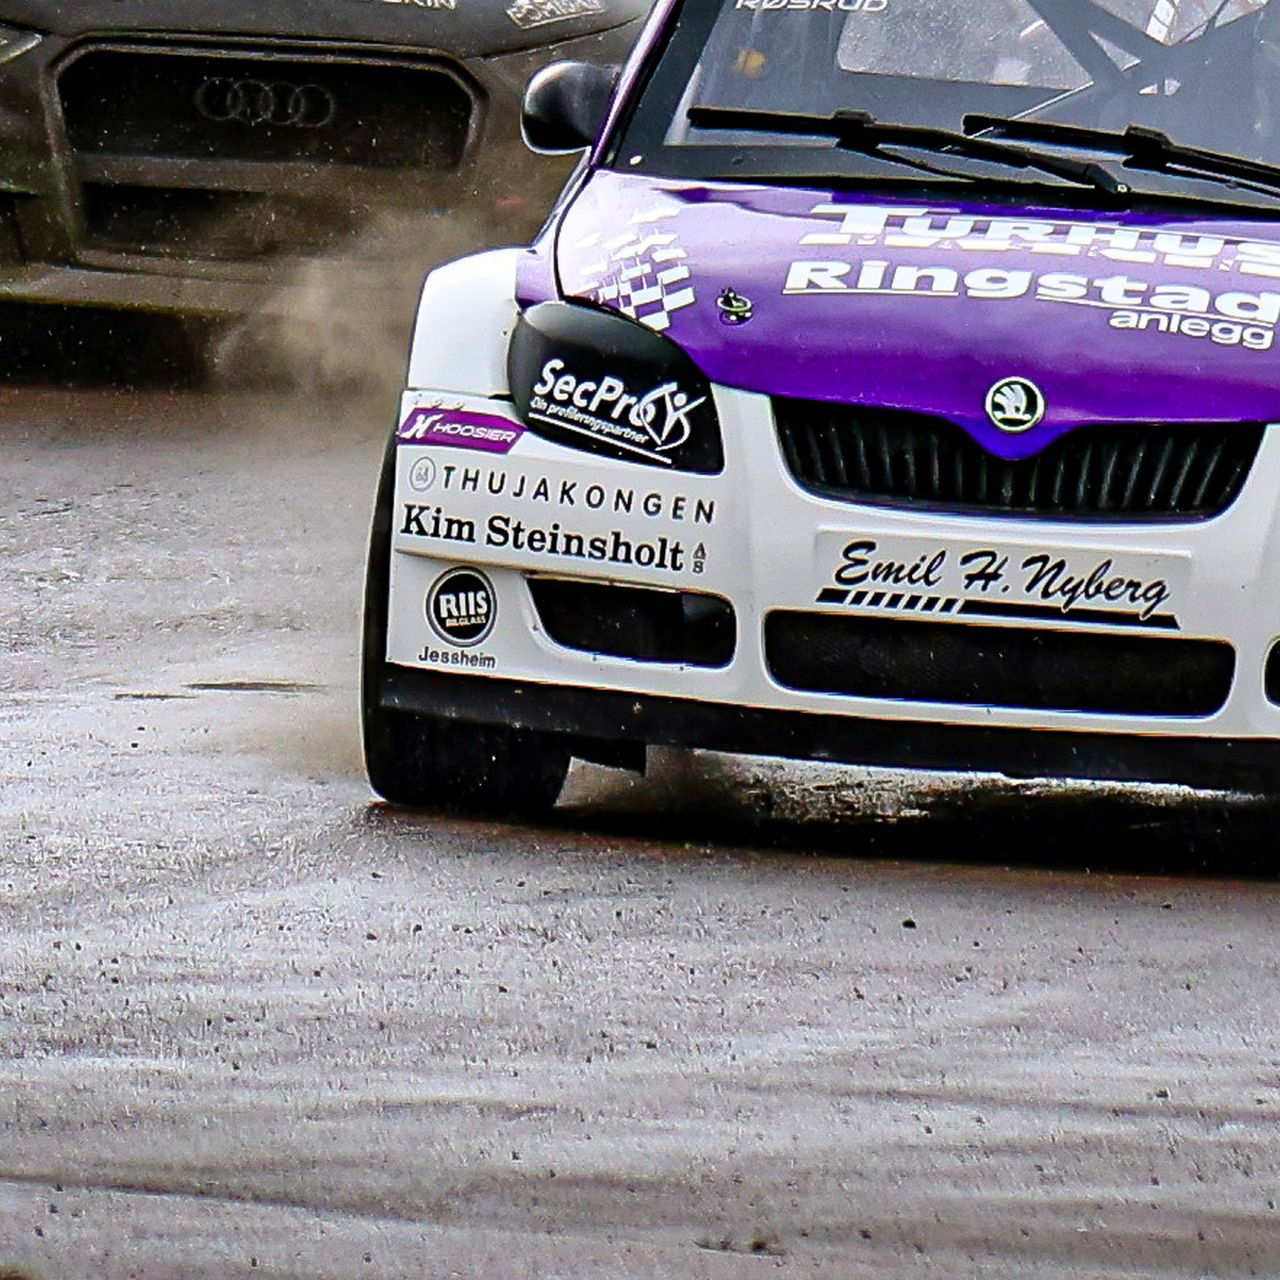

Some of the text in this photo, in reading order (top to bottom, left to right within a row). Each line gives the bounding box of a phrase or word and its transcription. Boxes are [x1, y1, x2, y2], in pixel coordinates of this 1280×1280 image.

[1108, 308, 1275, 351] anlegg
[533, 358, 657, 427] SecPro
[432, 423, 517, 443] HOOSIER
[442, 465, 715, 524] THUJAKONGEN
[400, 503, 476, 543] Kim
[485, 515, 685, 572] Steinsholt
[438, 589, 489, 619] RIIS
[834, 539, 1174, 620] Emil H. Nyberg
[418, 645, 497, 669] Jessheim
